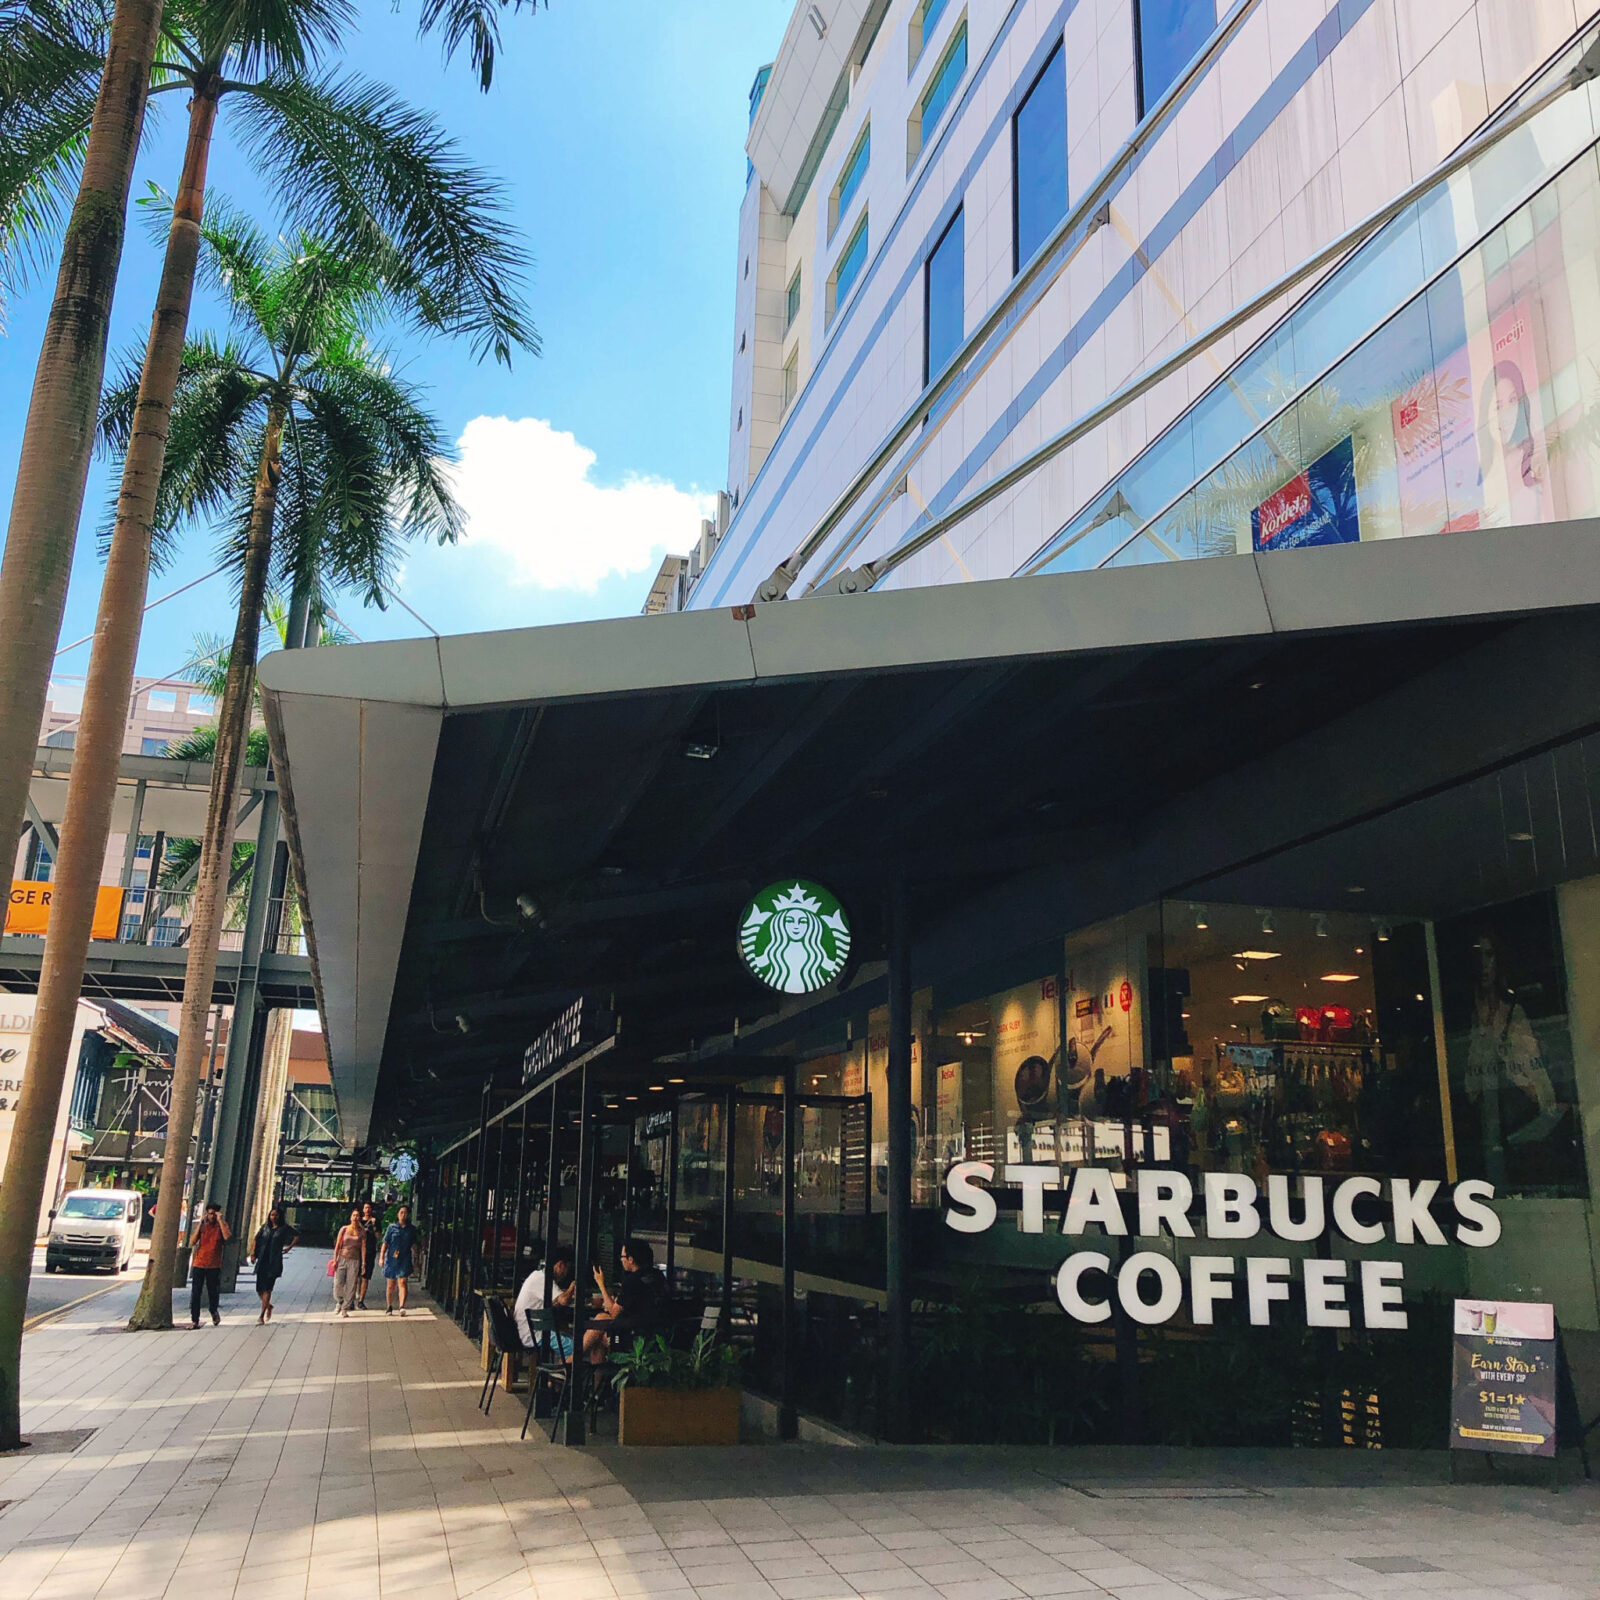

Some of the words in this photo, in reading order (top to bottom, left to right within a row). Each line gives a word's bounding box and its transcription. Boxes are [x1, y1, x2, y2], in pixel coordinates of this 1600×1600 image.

[1495, 319, 1524, 352] meiji
[944, 1162, 1501, 1247] STARBUCKS
[1056, 1251, 1408, 1329] COFFEE
[1471, 1352, 1503, 1369] Earn
[1505, 1356, 1537, 1373] Stars
[1480, 1371, 1496, 1380] WITH
[1496, 1372, 1515, 1382] EVERY
